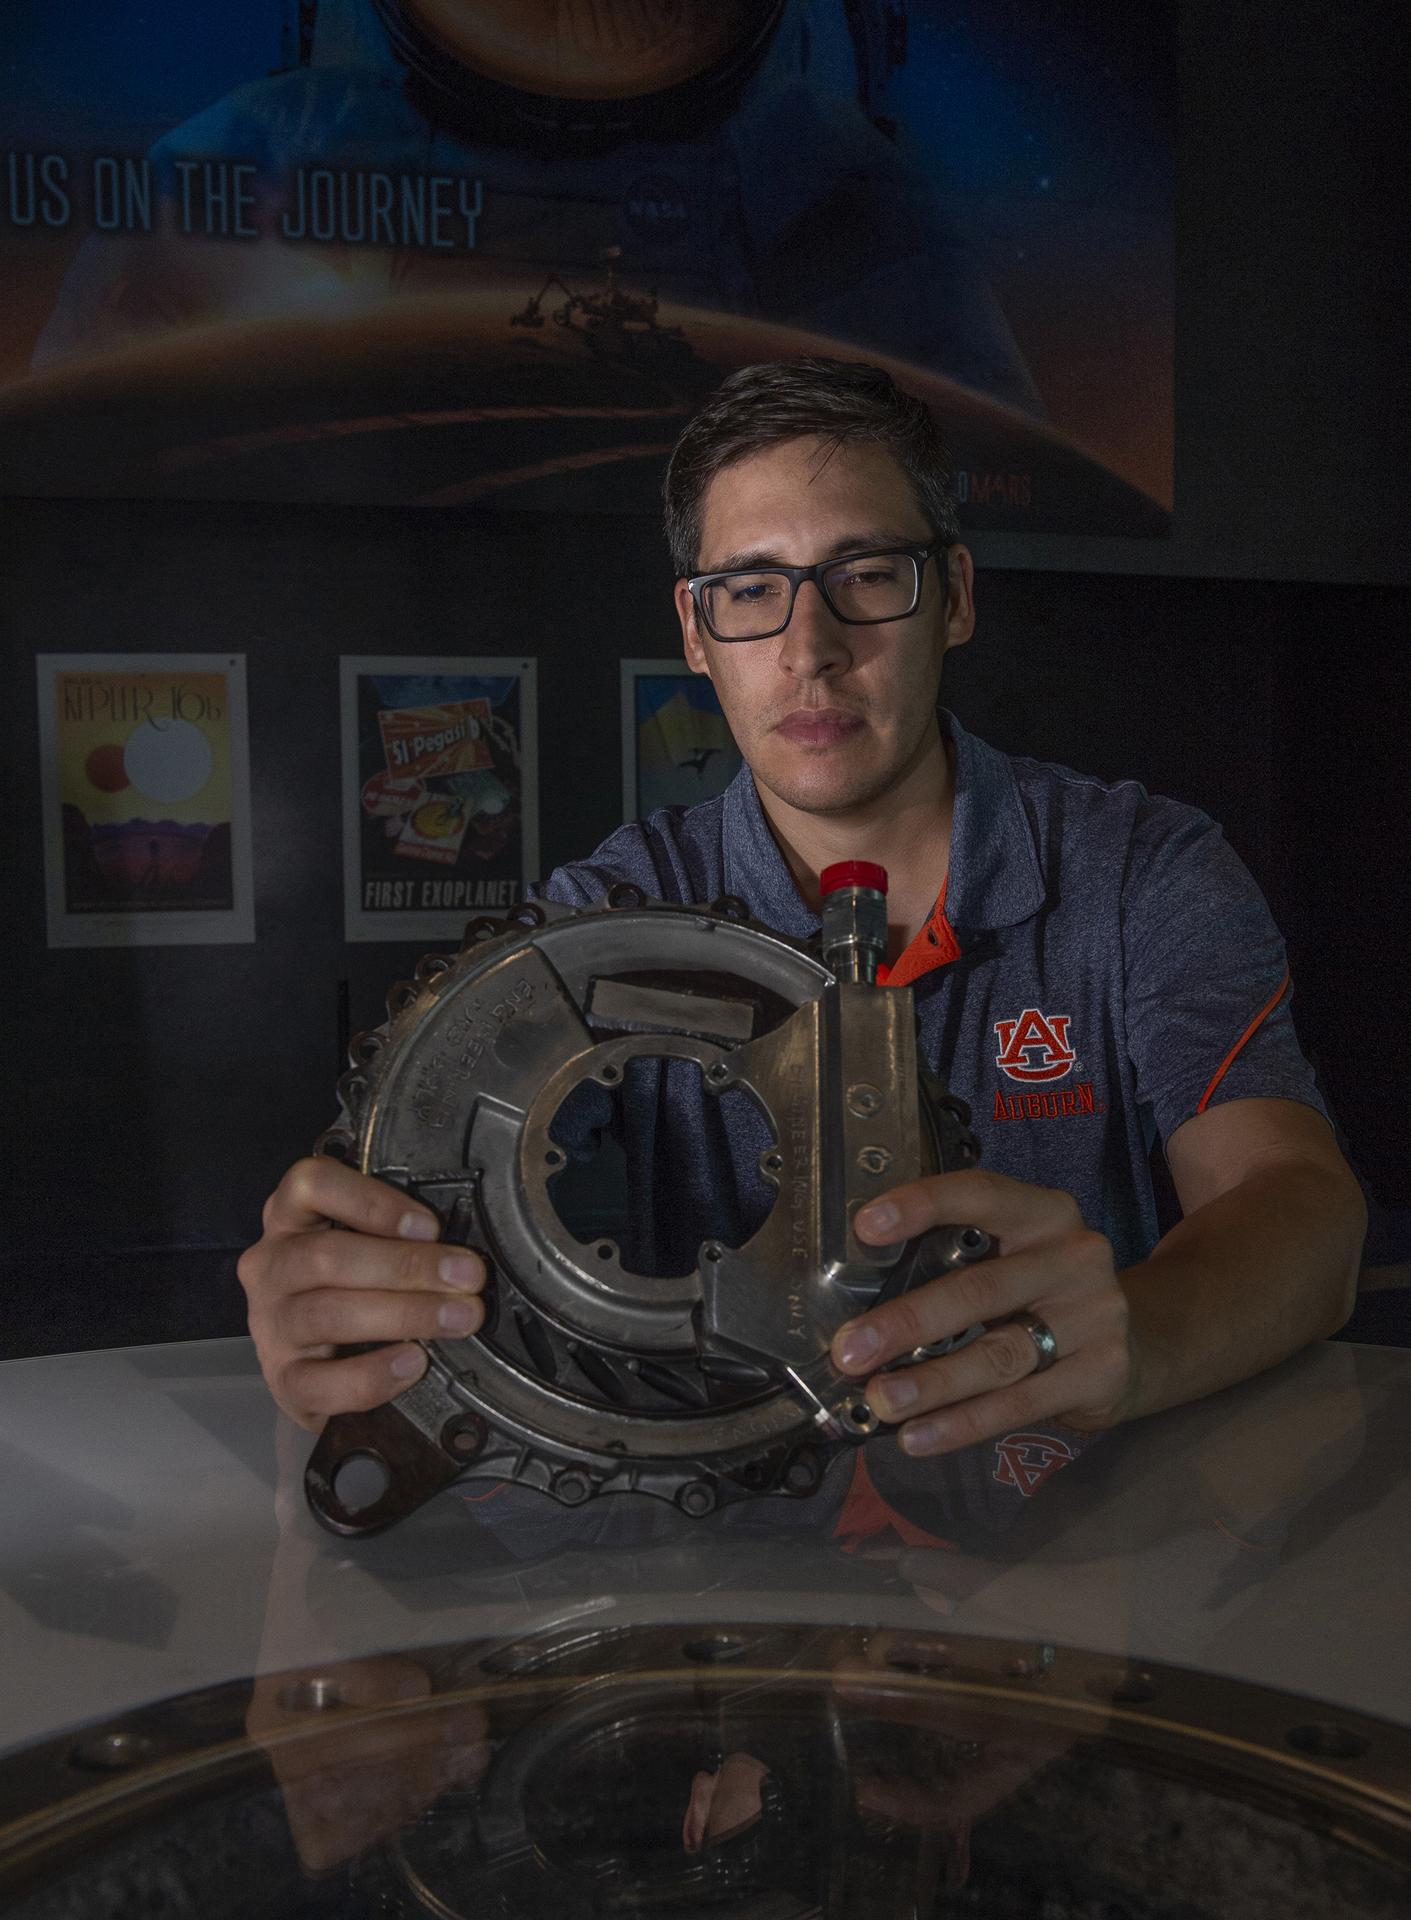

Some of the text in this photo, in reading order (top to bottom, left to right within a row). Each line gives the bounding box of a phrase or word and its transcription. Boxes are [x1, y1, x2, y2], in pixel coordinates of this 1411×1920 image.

[8, 153, 484, 249] US ON THE JOURNEY
[413, 721, 465, 757] Pegasi
[364, 879, 518, 908] FIRST EXOPLANET
[993, 1081, 1096, 1121] AUBURN
[791, 1218, 810, 1259] USE
